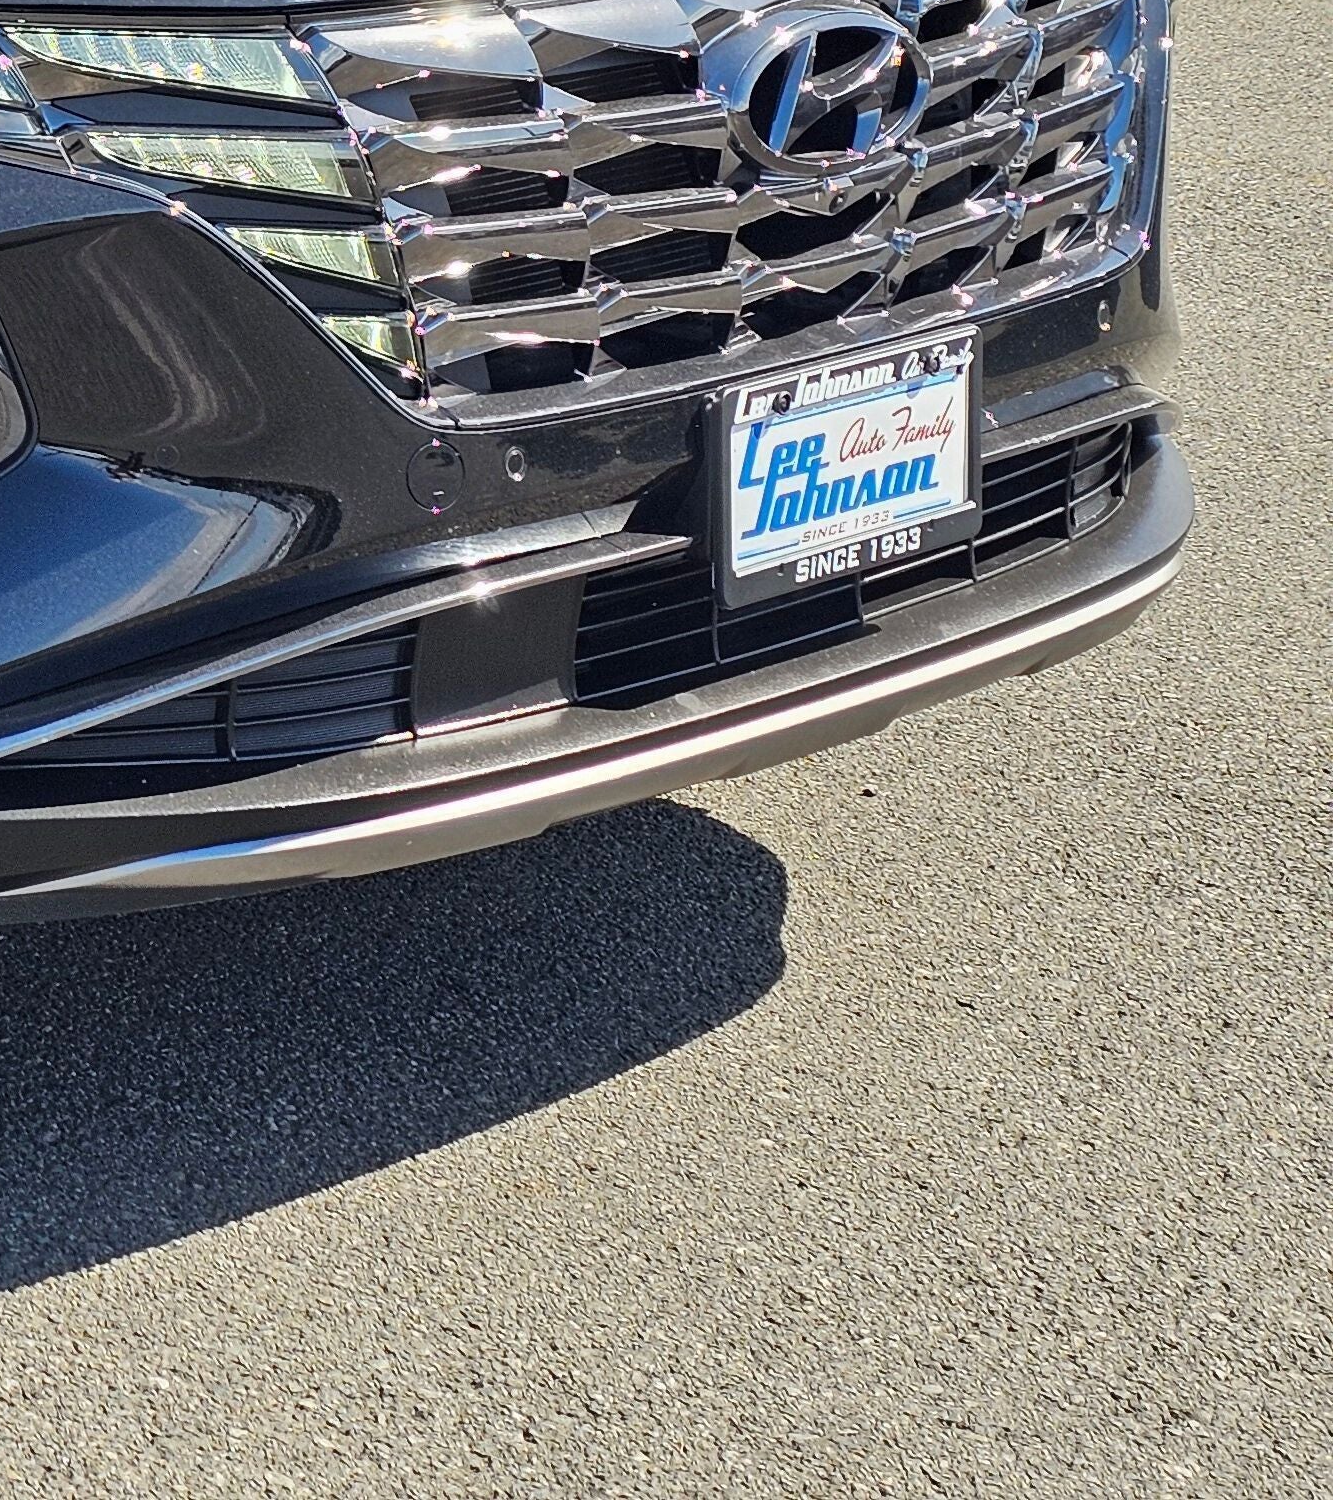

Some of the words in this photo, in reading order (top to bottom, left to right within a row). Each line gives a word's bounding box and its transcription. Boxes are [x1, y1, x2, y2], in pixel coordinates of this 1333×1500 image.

[793, 362, 897, 407] Johnson
[737, 421, 830, 491] Lee
[839, 417, 888, 464] Auto
[891, 396, 956, 453] Family
[740, 453, 940, 541] Johnson
[800, 521, 846, 544] SINCE
[854, 509, 891, 531] 1933
[795, 543, 860, 584] SINCE
[869, 526, 921, 563] 1933
